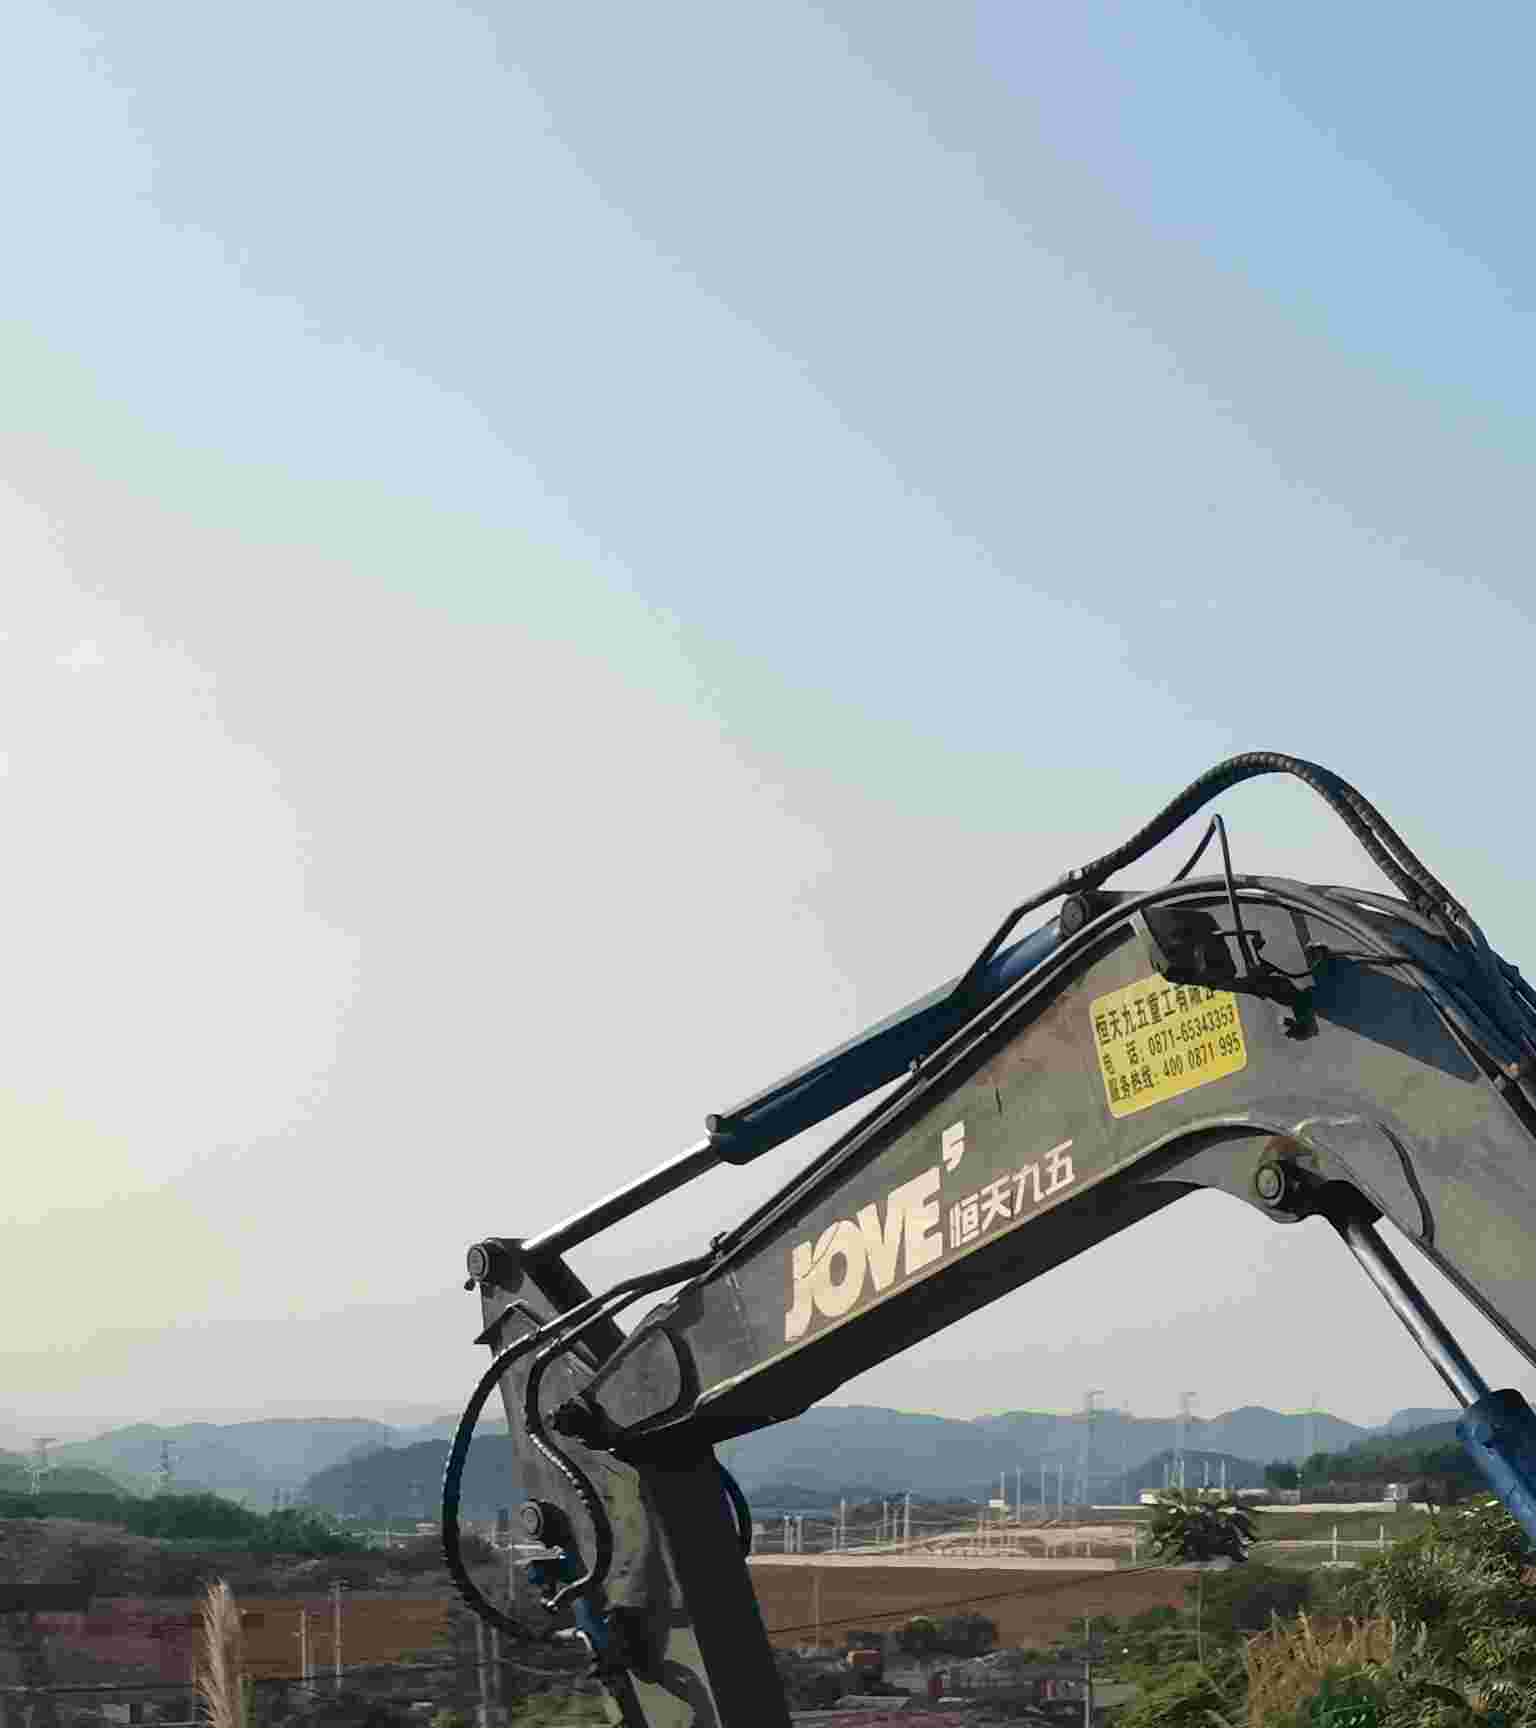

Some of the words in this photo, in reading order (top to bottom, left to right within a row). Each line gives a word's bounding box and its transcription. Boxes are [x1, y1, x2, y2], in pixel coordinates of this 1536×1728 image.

[784, 1166, 943, 1344] JOVE
[949, 1139, 1076, 1249] 恒天九五
